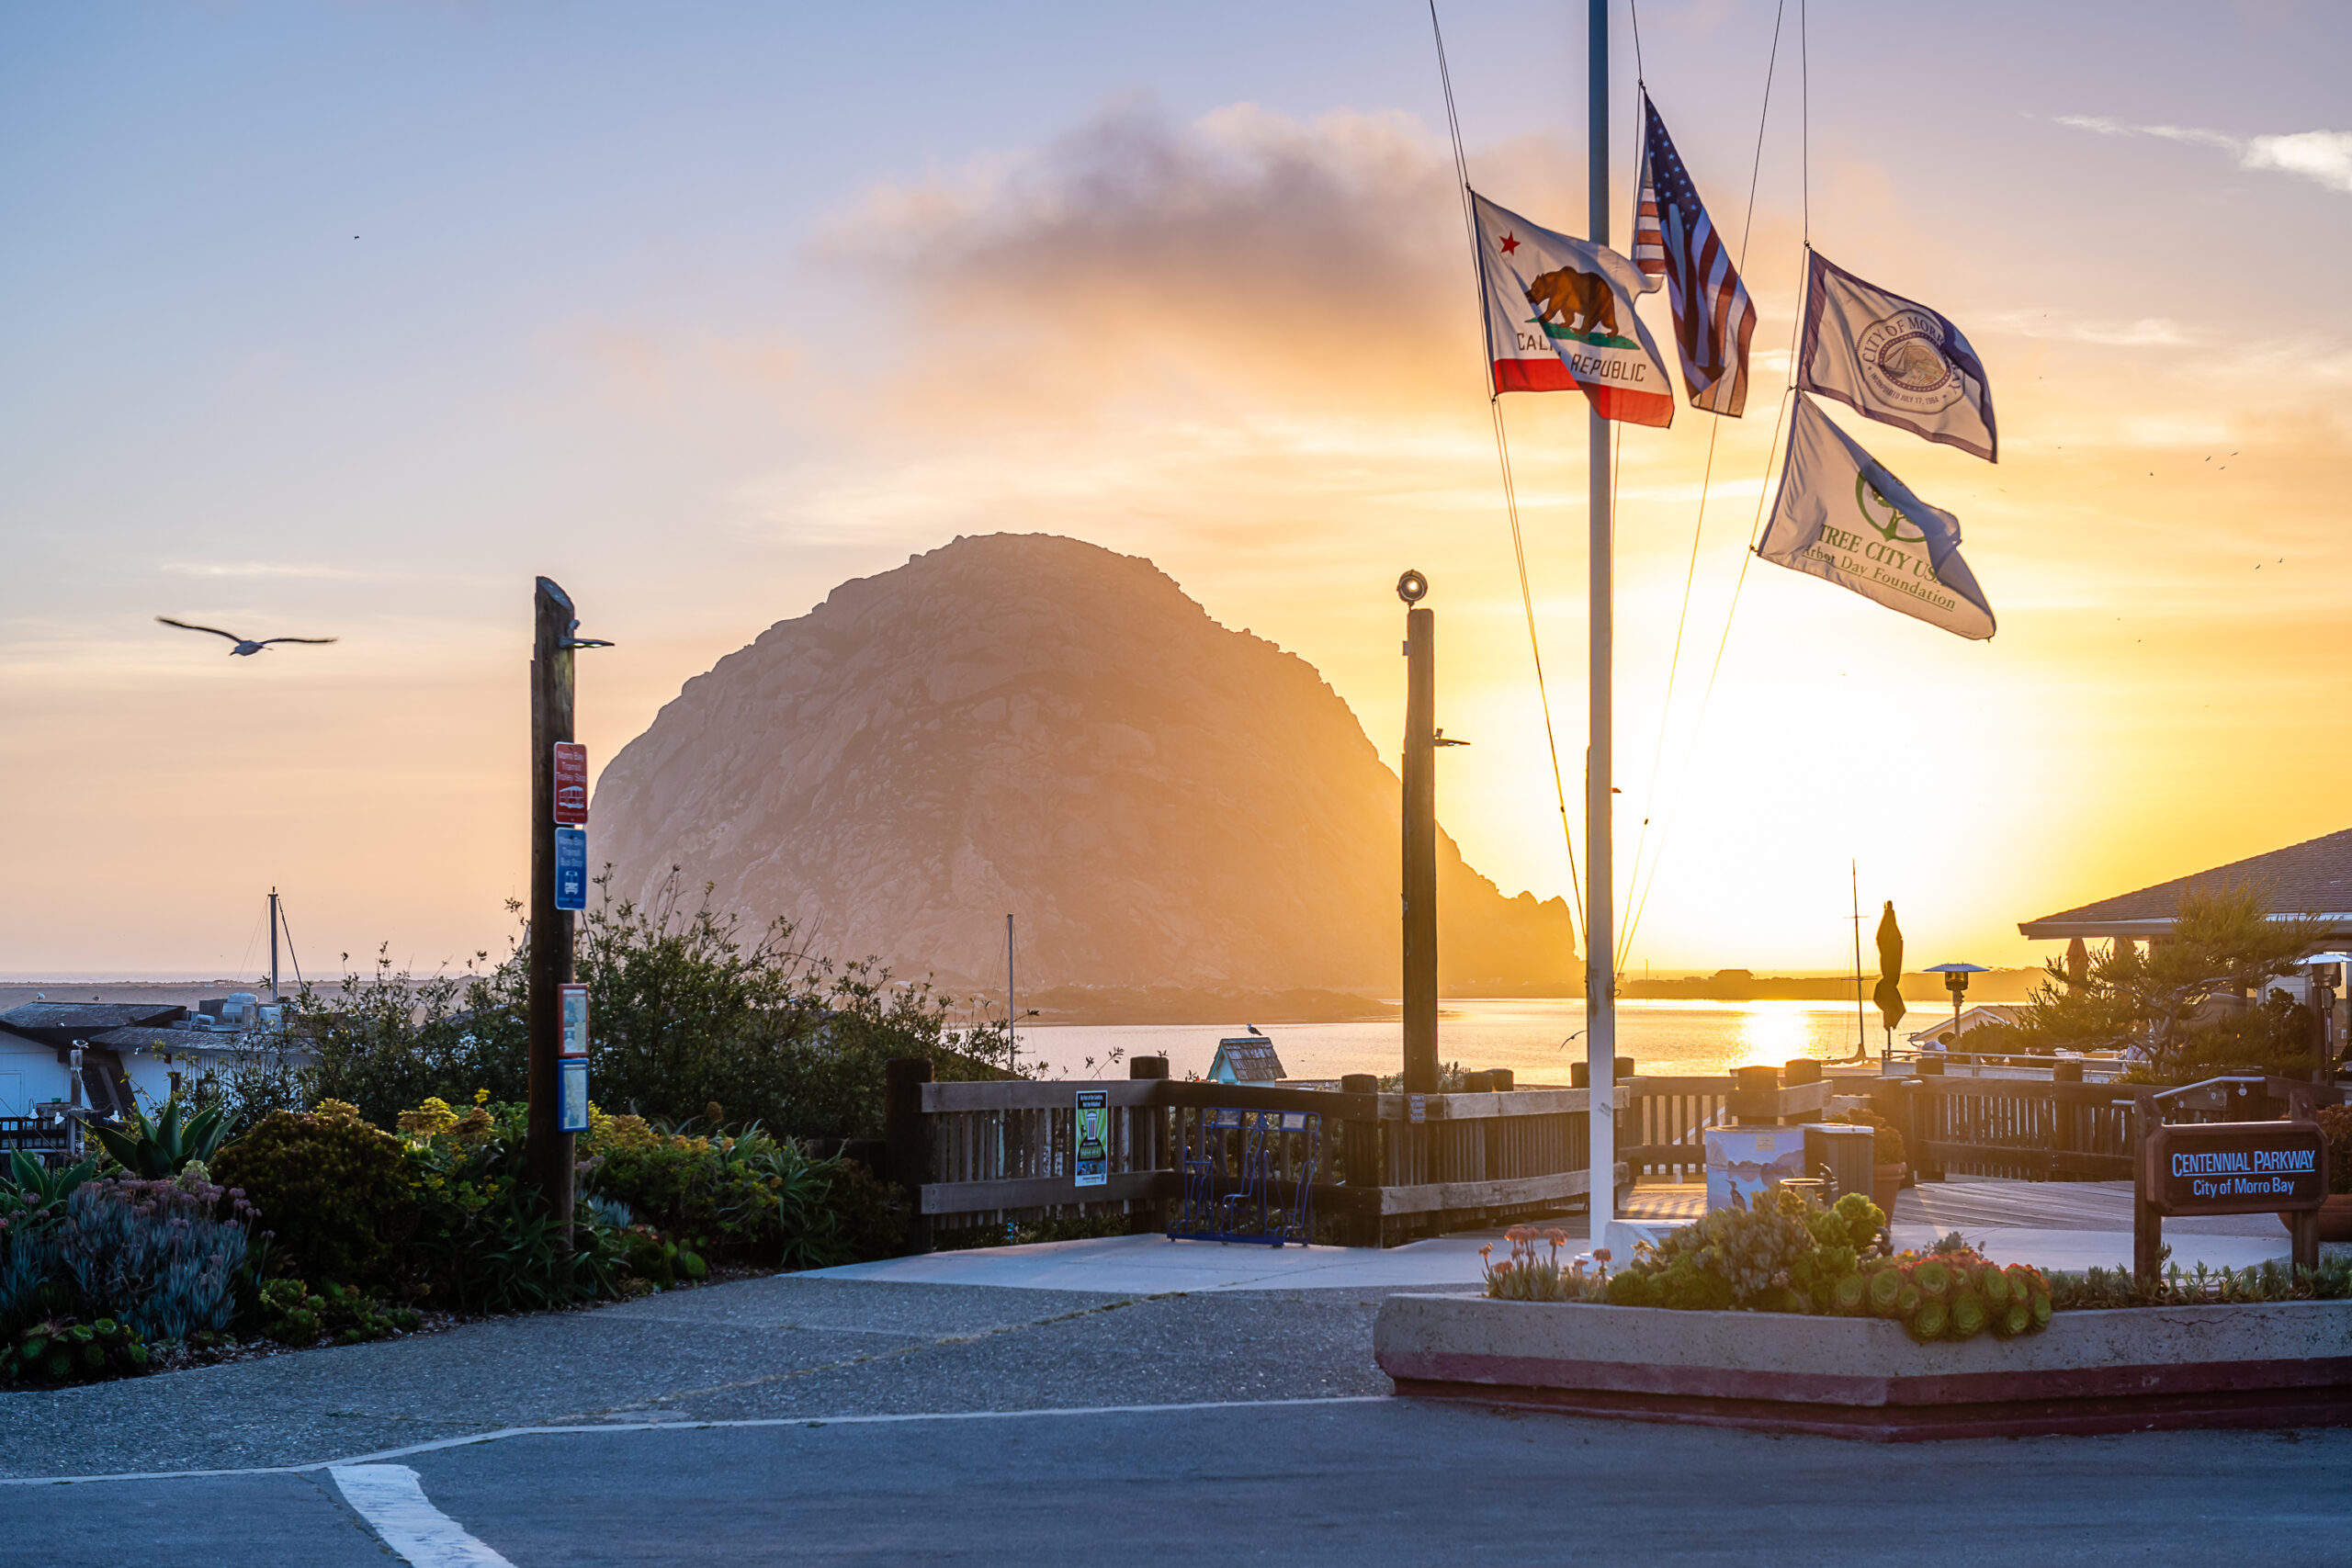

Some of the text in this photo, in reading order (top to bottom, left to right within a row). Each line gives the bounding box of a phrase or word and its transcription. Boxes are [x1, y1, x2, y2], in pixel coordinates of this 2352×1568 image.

[1862, 329, 1884, 363] CITY
[1885, 319, 1905, 336] OF
[1907, 316, 1945, 345] MORR
[1570, 354, 1646, 382] REPUBLIC
[1817, 524, 1943, 586] TREE CITY US
[1840, 556, 1869, 578] Day
[1872, 568, 1956, 610] Foundation
[2172, 1150, 2315, 1178] CENTENNIAL PARKWAY
[2193, 1177, 2295, 1198] City of Morro Bay
